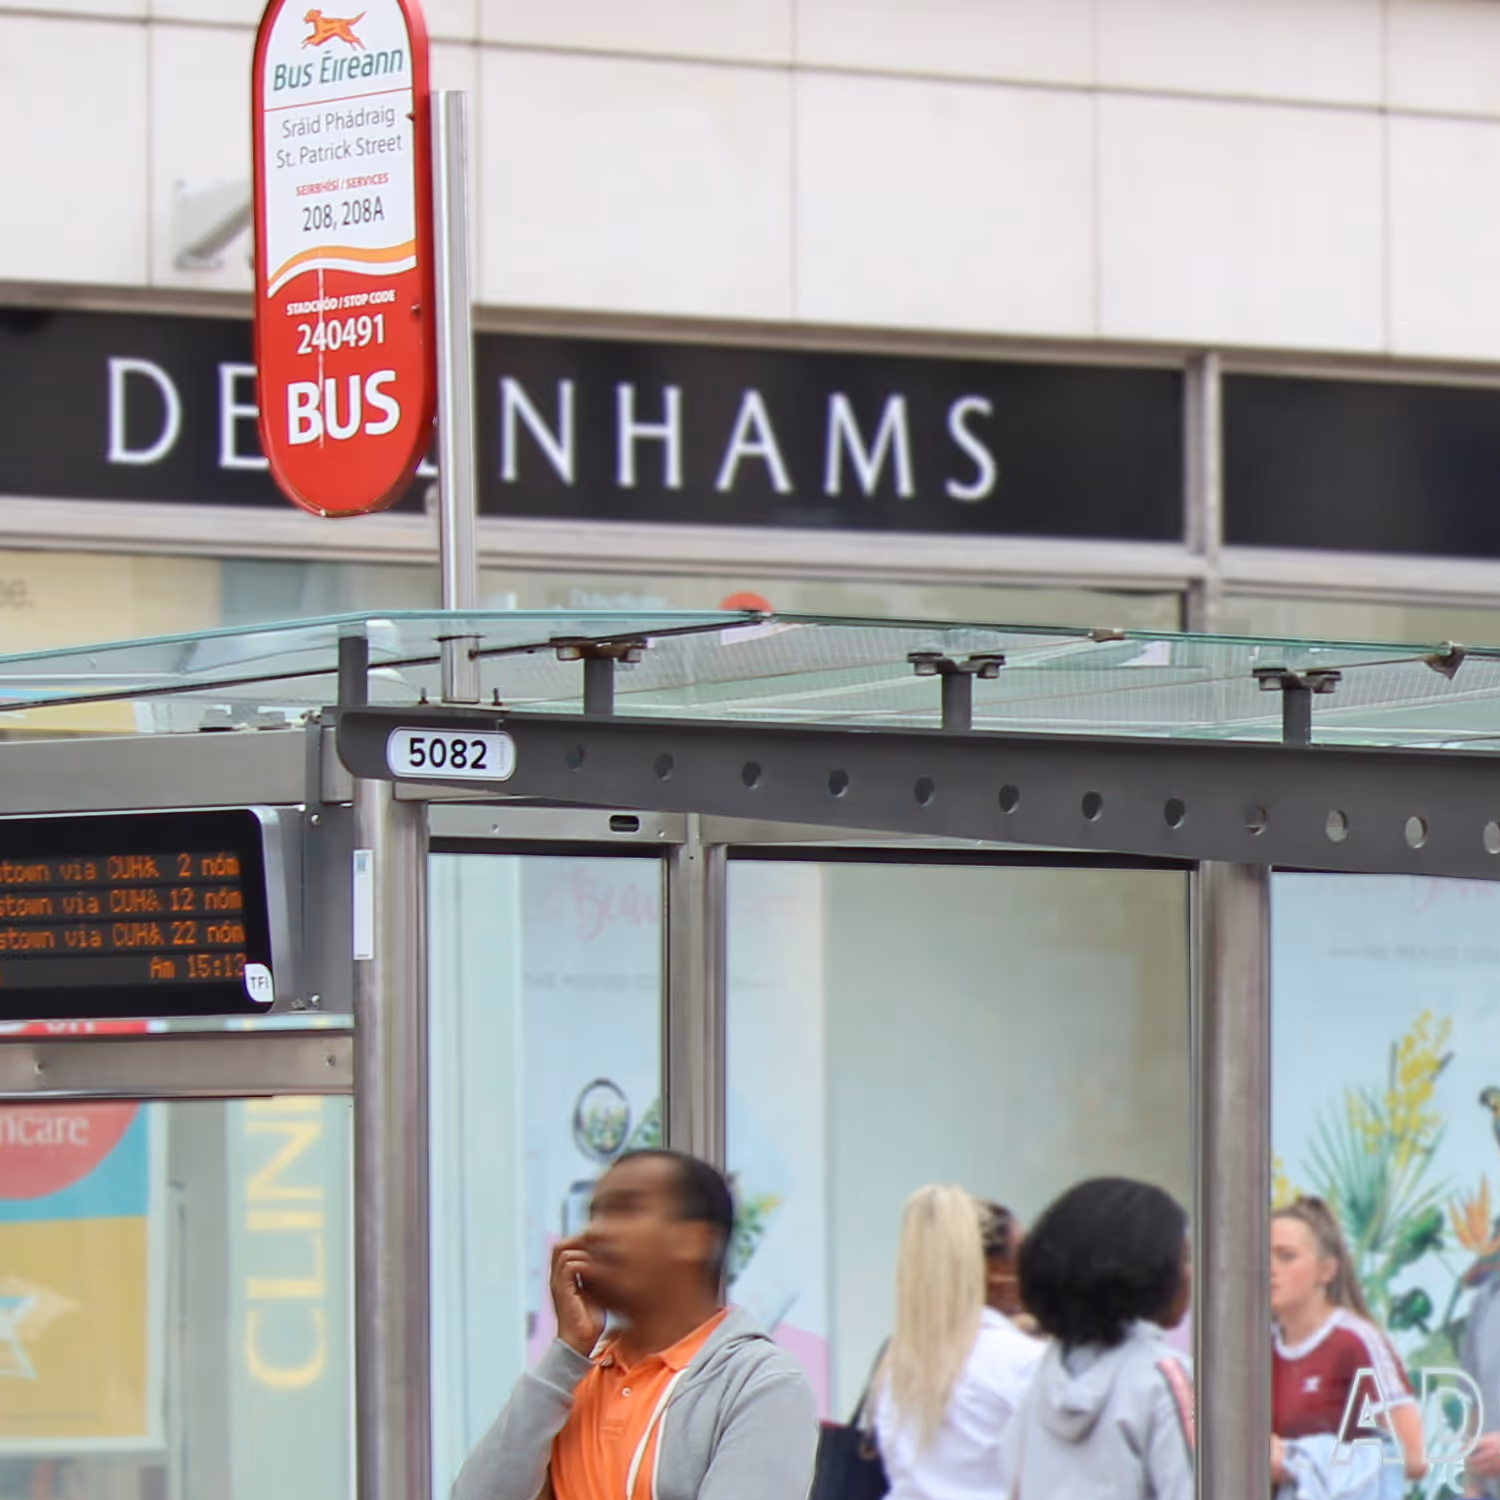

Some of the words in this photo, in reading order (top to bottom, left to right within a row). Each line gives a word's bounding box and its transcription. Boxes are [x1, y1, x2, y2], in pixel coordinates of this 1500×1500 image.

[273, 62, 312, 89] Bus
[320, 50, 403, 82] Éireann
[282, 115, 320, 137] Sráid
[325, 106, 395, 130] Phádraig
[276, 149, 294, 167] St.
[299, 139, 350, 163] Patrick
[356, 134, 402, 156] Street
[345, 172, 389, 188] SERVICES
[302, 204, 337, 230] 208,
[341, 195, 384, 224] 208A
[286, 296, 336, 314] STADCHÓD
[343, 292, 367, 306] STOP
[369, 289, 395, 303] CODE
[297, 313, 383, 353] 240491
[287, 369, 401, 446] BUS
[107, 356, 998, 501] DENHAMS
[409, 737, 487, 770] 5082
[0, 859, 50, 885] town
[59, 858, 97, 881] via
[177, 853, 192, 877] 2
[201, 852, 240, 877] nóm
[62, 891, 100, 914] via
[170, 887, 195, 911] 12
[204, 888, 243, 911] nóm
[65, 925, 103, 948] via
[171, 921, 197, 945] 22
[207, 919, 246, 943] nóm
[249, 976, 270, 991] TFI
